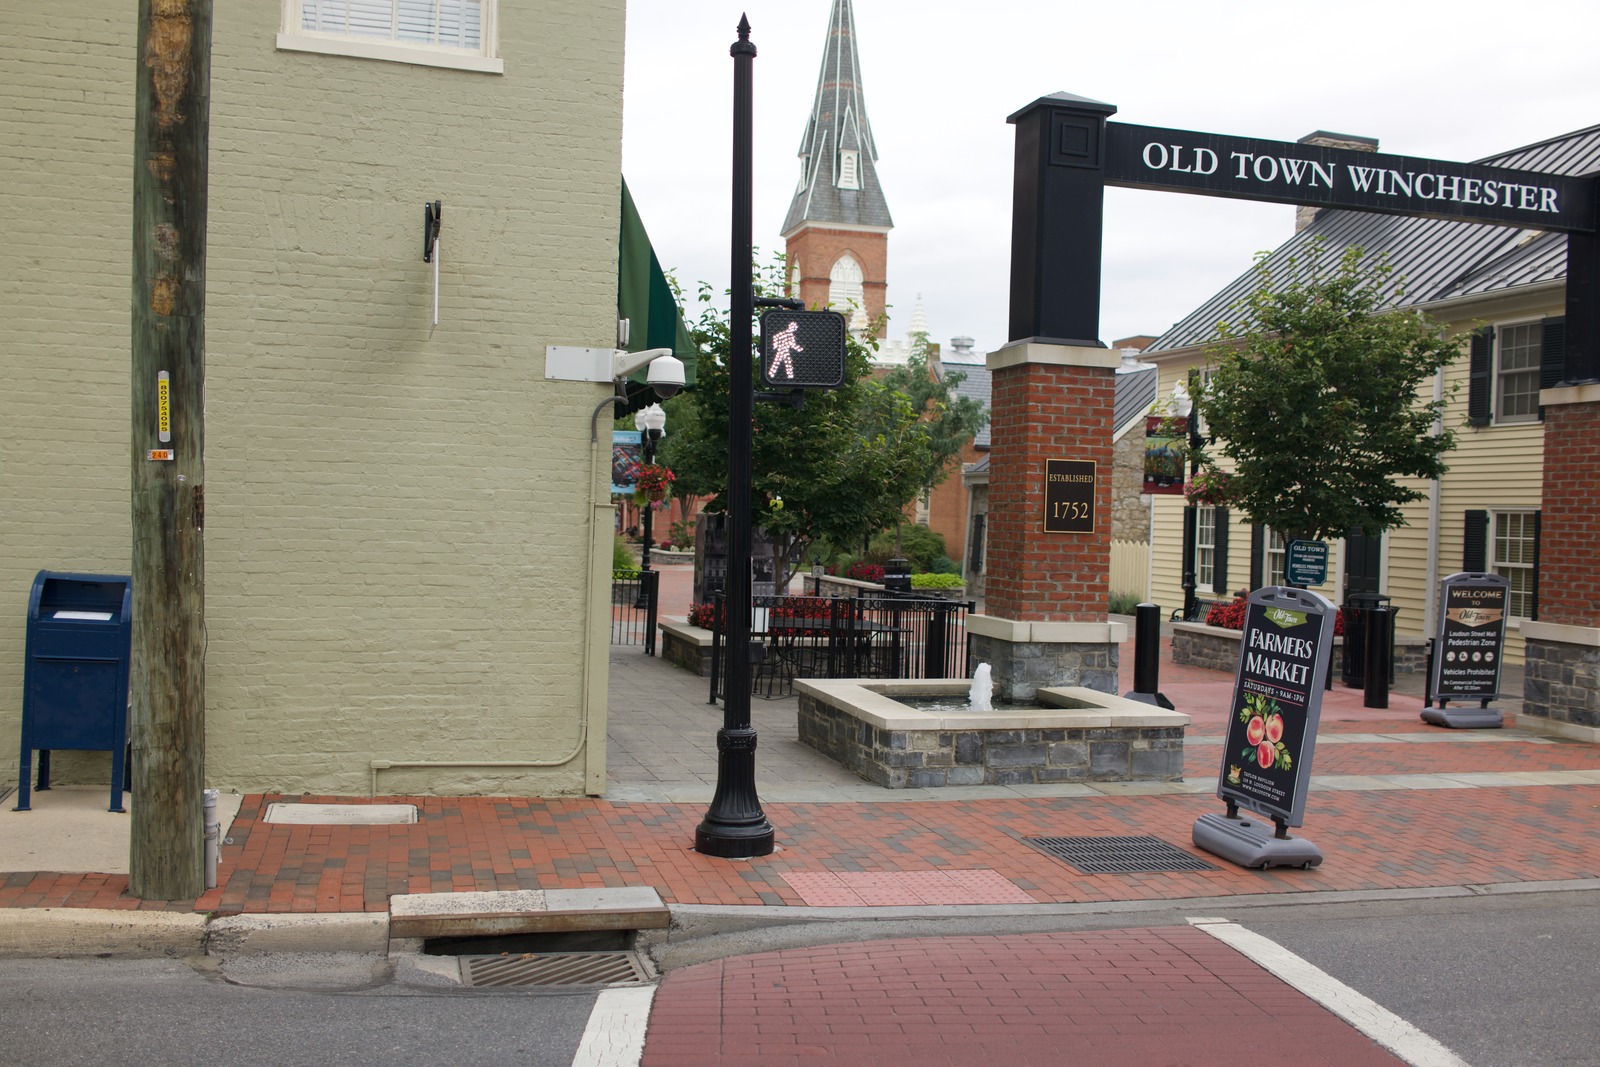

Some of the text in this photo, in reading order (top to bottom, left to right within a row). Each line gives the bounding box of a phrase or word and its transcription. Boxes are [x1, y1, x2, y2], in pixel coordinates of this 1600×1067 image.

[1142, 141, 1560, 213] OLD TOWN WINCHESTER
[160, 385, 168, 432] 800754095
[152, 451, 168, 459] 240
[1049, 473, 1093, 483] ESTABLISHED
[1053, 501, 1089, 520] 1752
[1452, 590, 1503, 599] WELCOME
[1249, 627, 1314, 659] FARMERS
[1448, 638, 1480, 646] Pedestrian
[1245, 651, 1310, 686] MARKET
[1466, 668, 1496, 676] Prohibited
[1243, 680, 1275, 695] SATURDAYS
